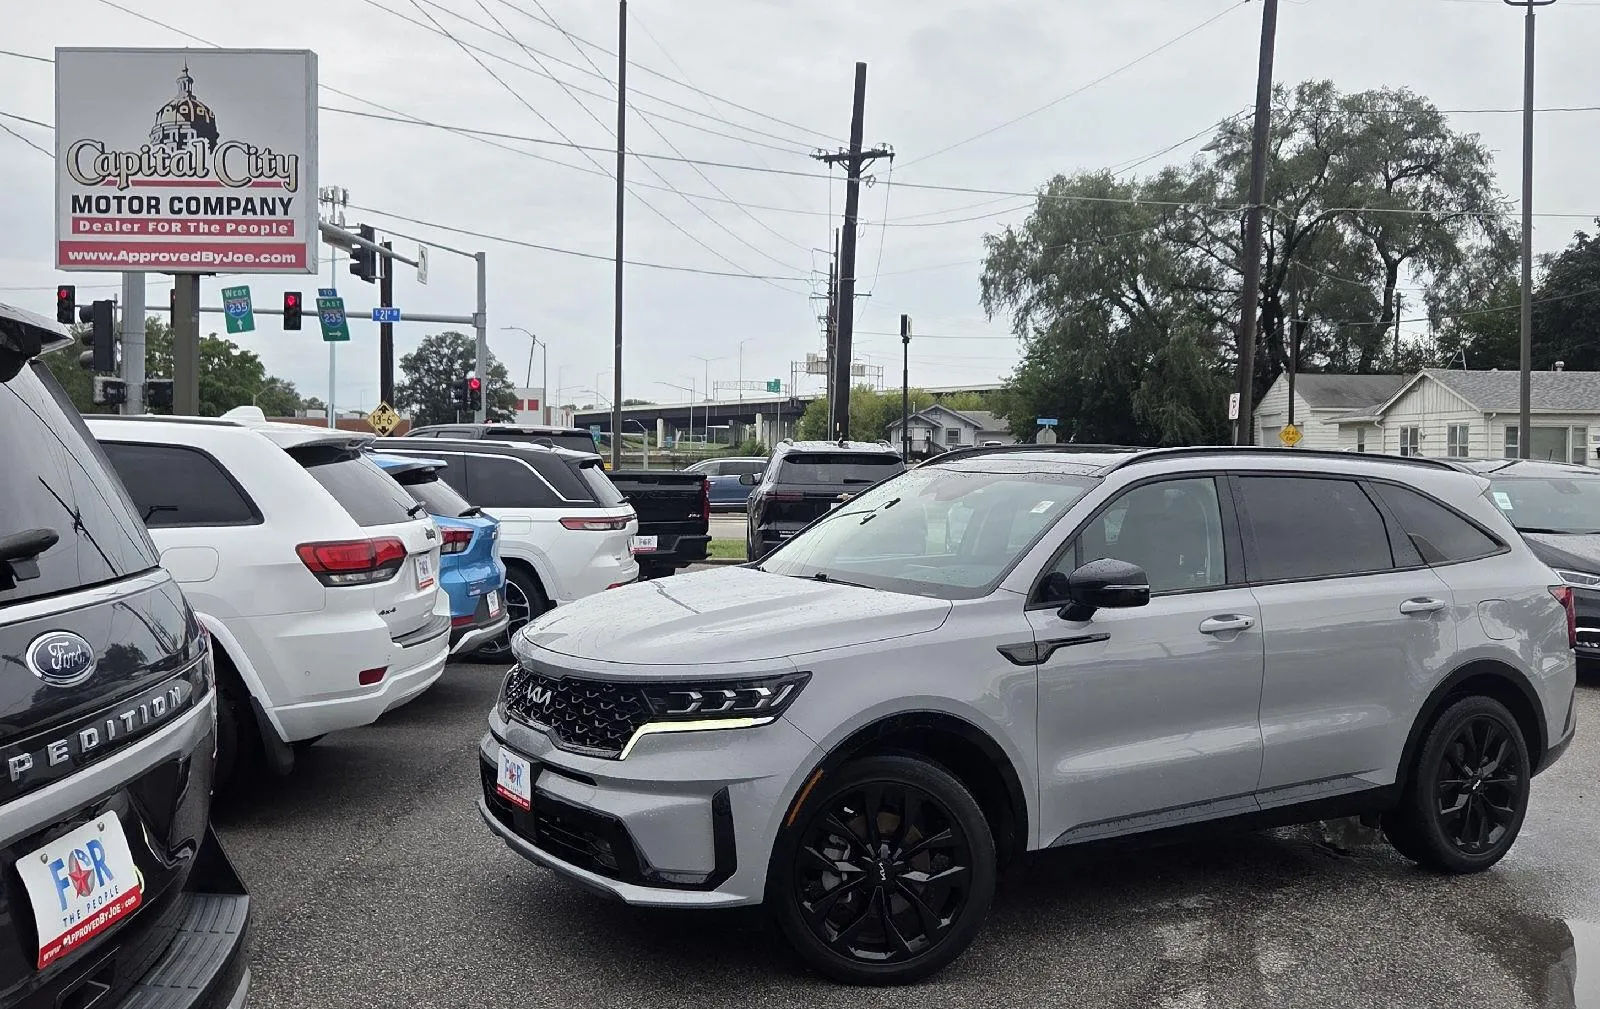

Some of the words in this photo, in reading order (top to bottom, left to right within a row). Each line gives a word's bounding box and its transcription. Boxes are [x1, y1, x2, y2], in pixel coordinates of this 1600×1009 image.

[66, 139, 209, 191] Capital
[214, 140, 299, 192] City
[72, 195, 161, 215] MOTOR
[169, 196, 294, 216] COMPANY
[79, 220, 141, 233] Dealer
[148, 222, 182, 233] FOR
[187, 222, 221, 234] The
[226, 222, 289, 236] People
[68, 249, 296, 264] www.ApprovedByJoe.com
[229, 303, 248, 314] 235
[47, 640, 86, 671] Ford
[8, 686, 182, 783] PEDITION
[48, 838, 115, 912] FOR
[62, 908, 81, 928] THE
[86, 884, 120, 914] PEOPLE
